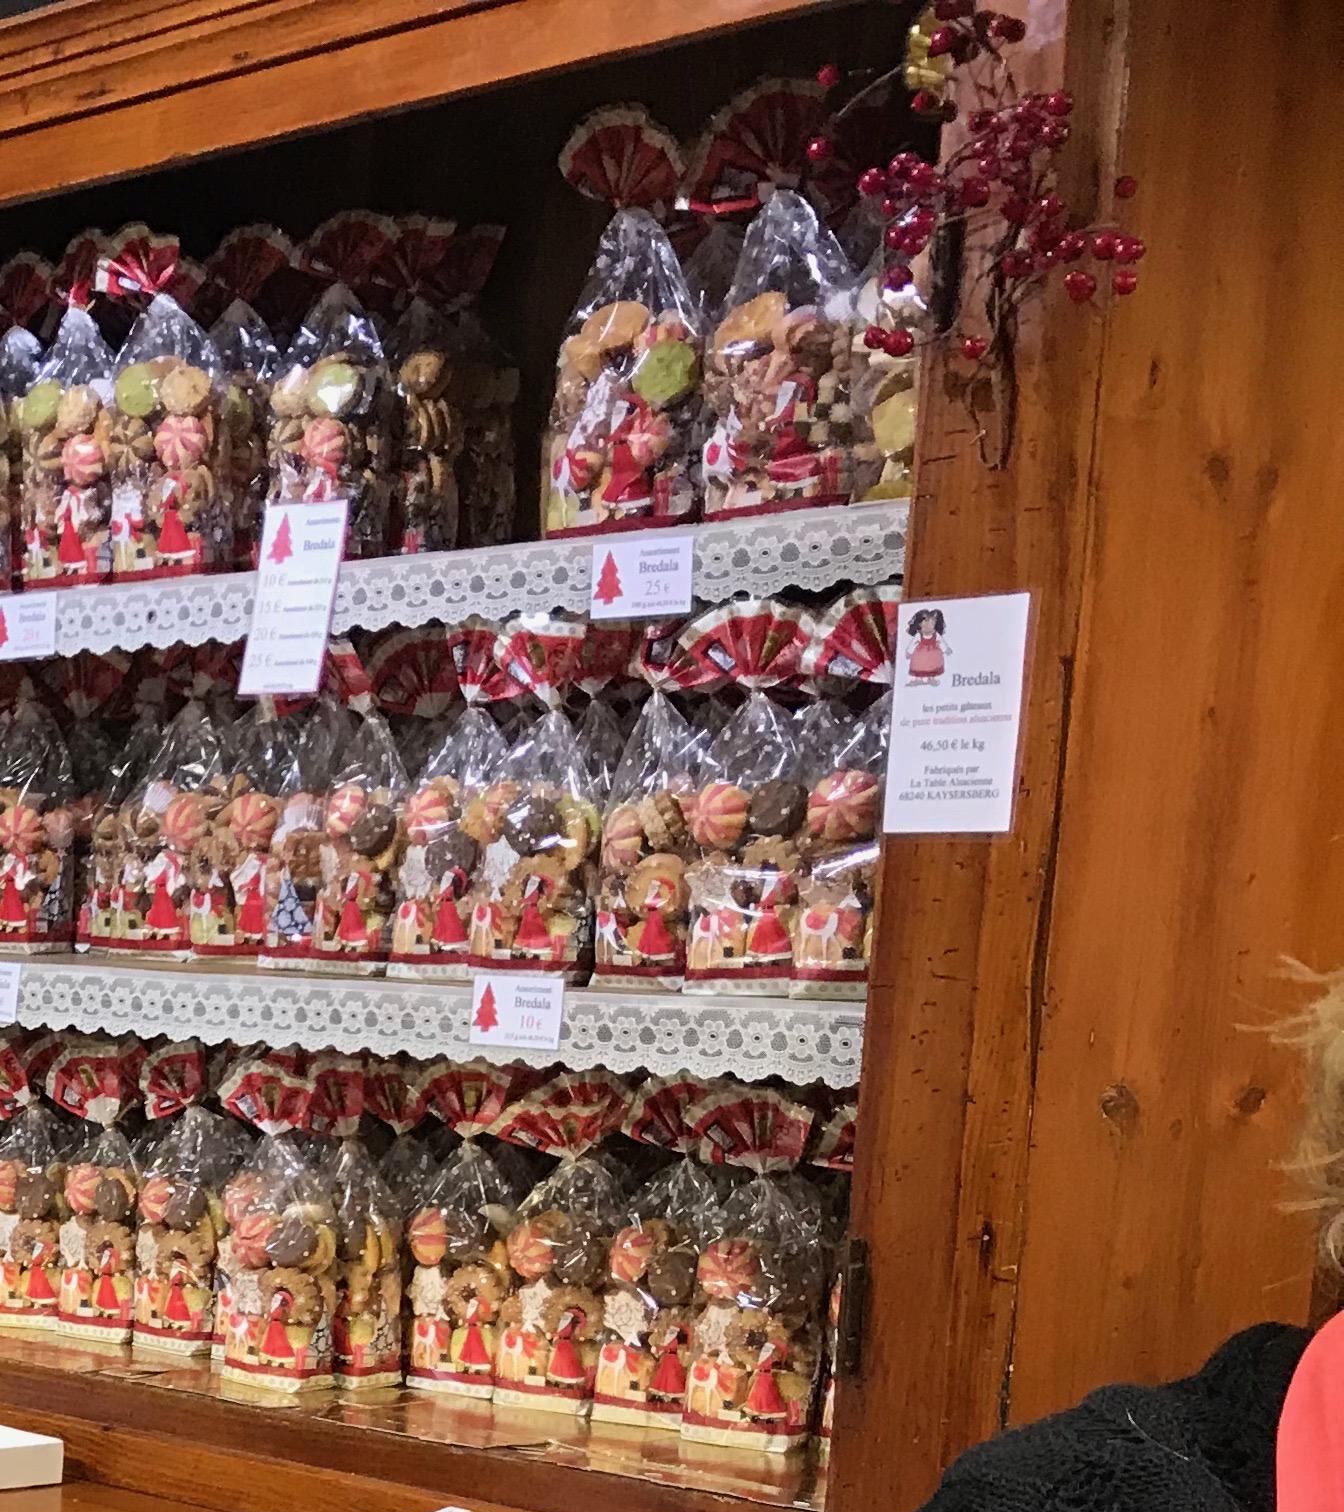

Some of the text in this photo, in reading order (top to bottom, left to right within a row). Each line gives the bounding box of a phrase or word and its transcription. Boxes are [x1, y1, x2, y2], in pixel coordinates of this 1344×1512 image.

[639, 547, 680, 556] Assortiment
[639, 559, 679, 574] Bredala
[645, 580, 671, 596] 25 €
[951, 672, 1001, 687] Bredala
[922, 703, 934, 713] les
[935, 703, 958, 714] petits
[950, 739, 960, 751] €
[960, 738, 970, 750] le
[972, 738, 985, 752] kg
[965, 764, 979, 776] par
[910, 777, 993, 788] La Table Alsacienne
[898, 789, 1000, 801] 68240 KAYSERSBERG
[514, 997, 551, 1010] Bredala
[520, 1014, 542, 1030] 10 €
